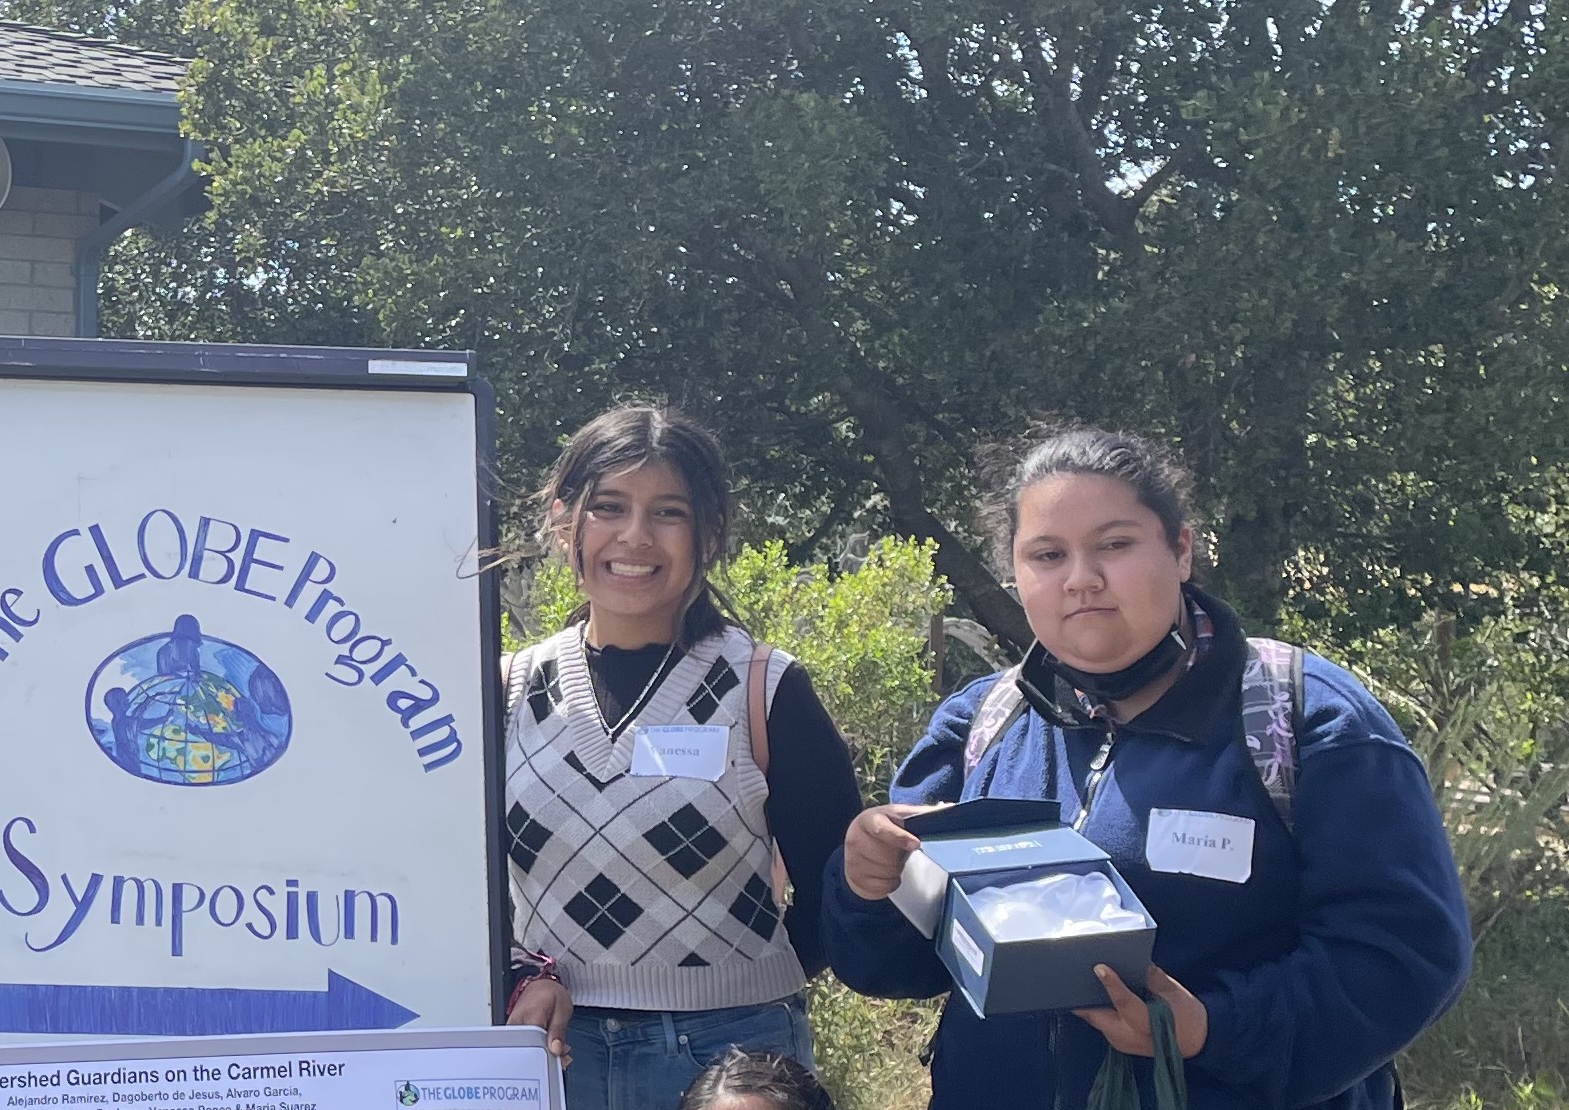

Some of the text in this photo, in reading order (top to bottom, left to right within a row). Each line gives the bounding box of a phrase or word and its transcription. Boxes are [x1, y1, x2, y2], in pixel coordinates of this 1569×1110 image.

[42, 509, 290, 607] GLOBE
[284, 551, 463, 773] Program
[1172, 832, 1234, 851] Maria P.
[66, 1066, 159, 1086] Guardians
[165, 1070, 186, 1082] on
[193, 1064, 221, 1081] the
[227, 1061, 292, 1079] Carmel
[298, 1059, 345, 1077] River
[6, 1094, 58, 1109] Alejandro
[112, 1090, 169, 1104] Dagoberto
[172, 1089, 185, 1100] de
[188, 1088, 224, 1100] Jesus,
[443, 1088, 480, 1100] GLOBE
